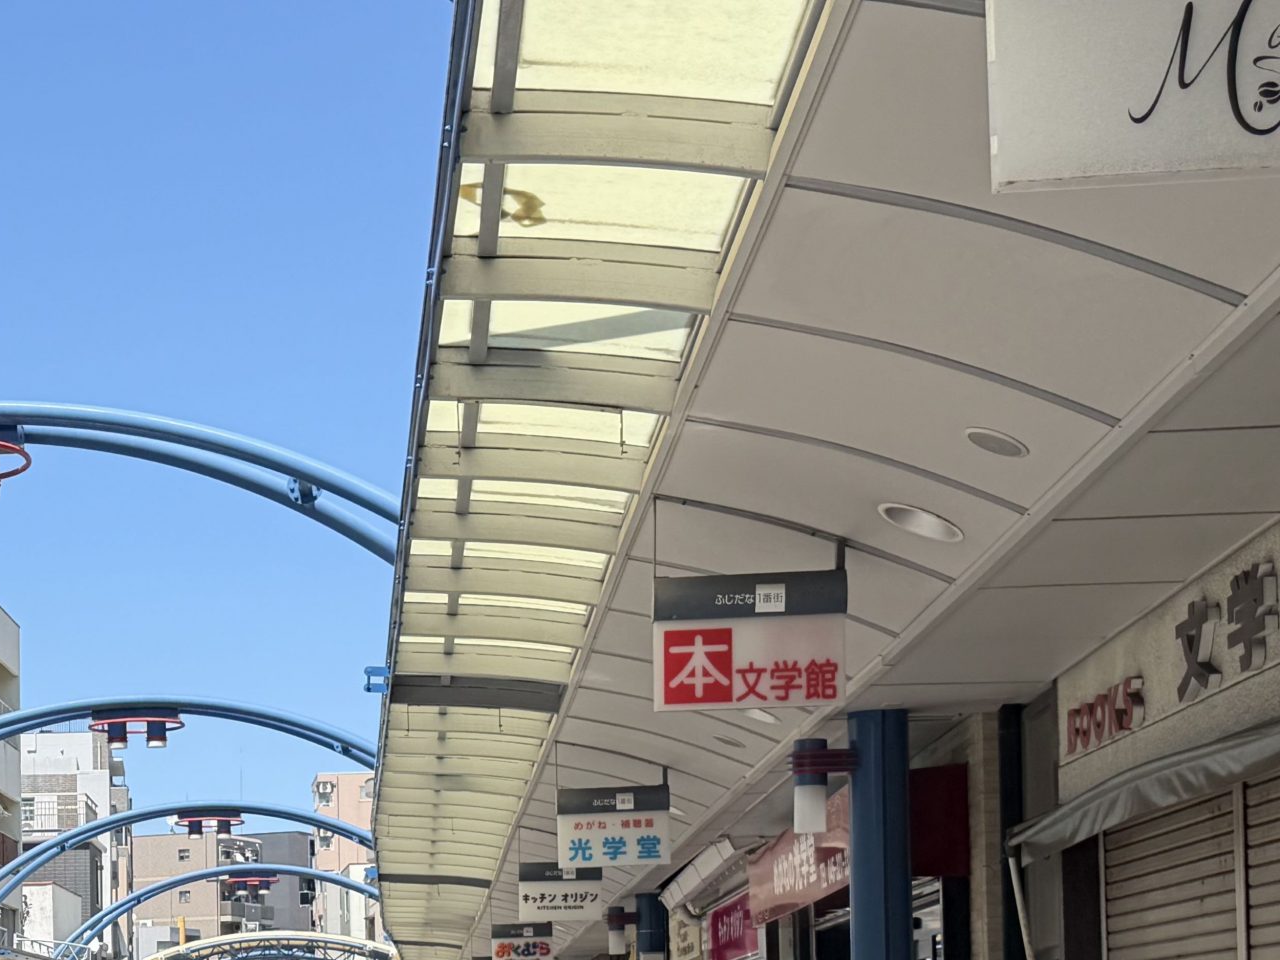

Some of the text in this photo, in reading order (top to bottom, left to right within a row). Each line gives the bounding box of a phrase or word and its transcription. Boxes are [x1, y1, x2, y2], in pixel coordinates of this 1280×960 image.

[735, 658, 839, 702] 文学館
[1066, 676, 1144, 754] BOOKS
[568, 835, 662, 862] 光学堂
[522, 891, 599, 904] キッチン オリジン
